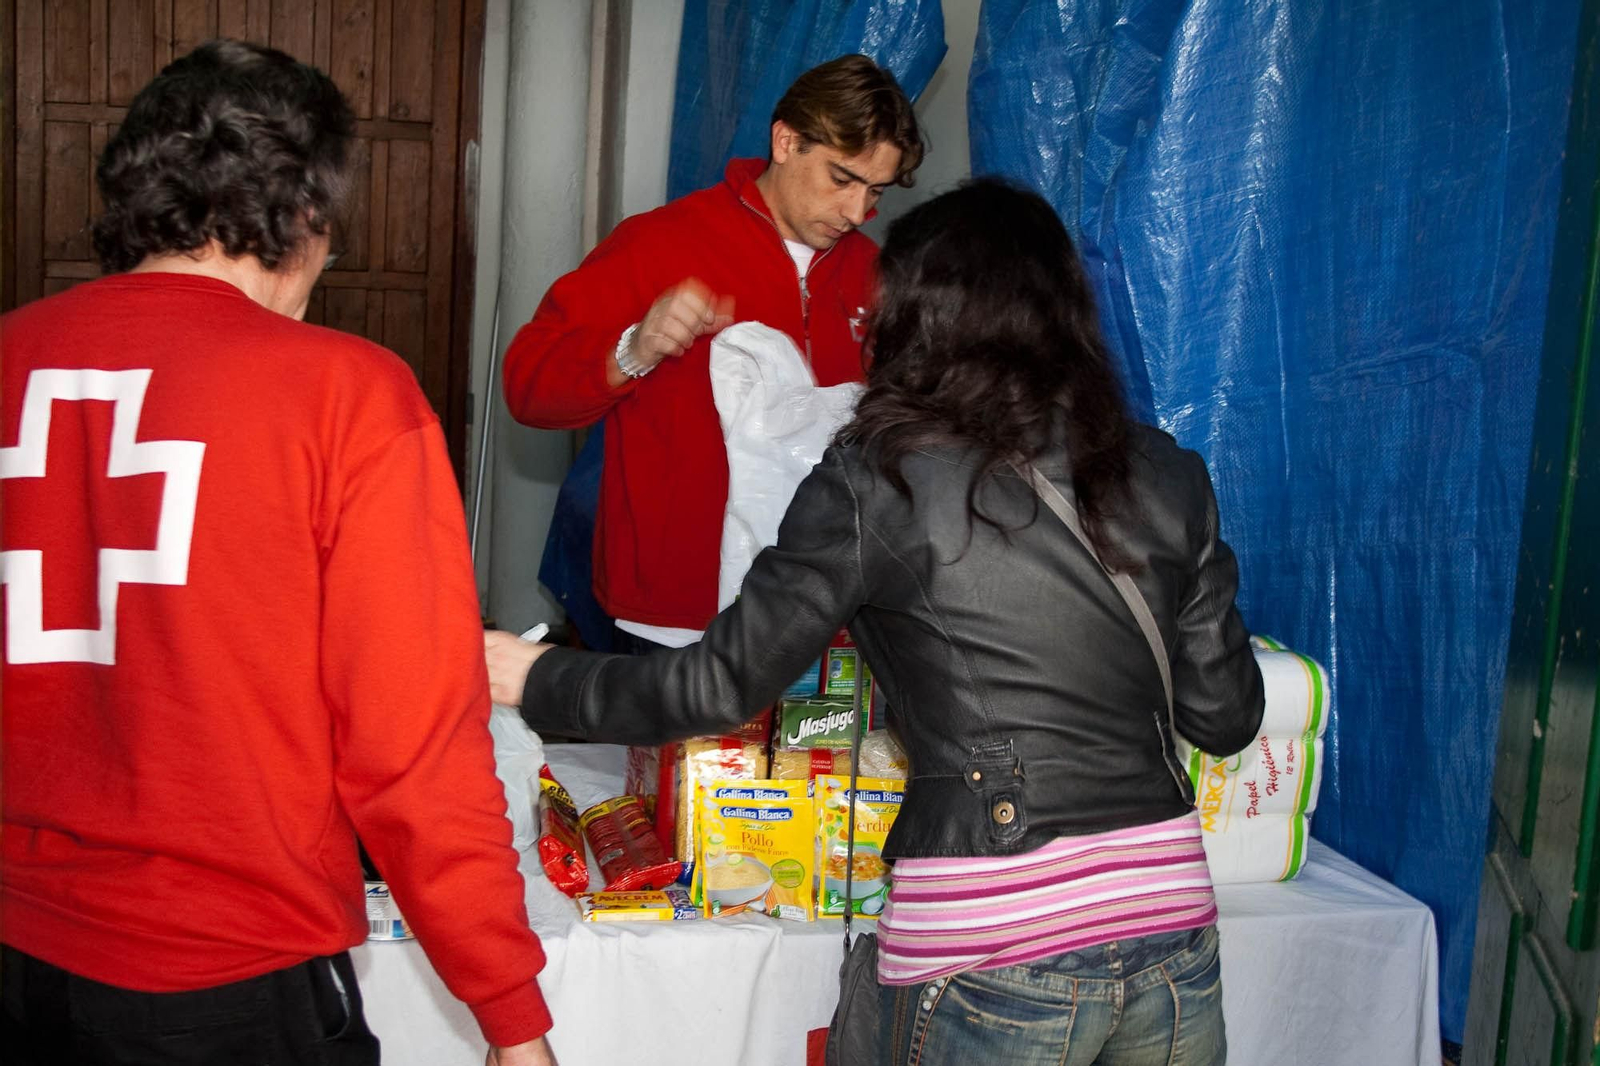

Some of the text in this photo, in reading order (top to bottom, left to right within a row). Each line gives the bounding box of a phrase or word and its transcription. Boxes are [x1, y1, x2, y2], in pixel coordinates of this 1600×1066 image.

[1260, 735, 1281, 796] Higiénico
[1286, 766, 1294, 775] 12
[718, 789, 785, 799] Gallina Blanca
[882, 791, 903, 803] Blan
[1243, 780, 1261, 819] Papel
[723, 807, 790, 820] Gallina Blanca
[742, 831, 774, 847] Pollo
